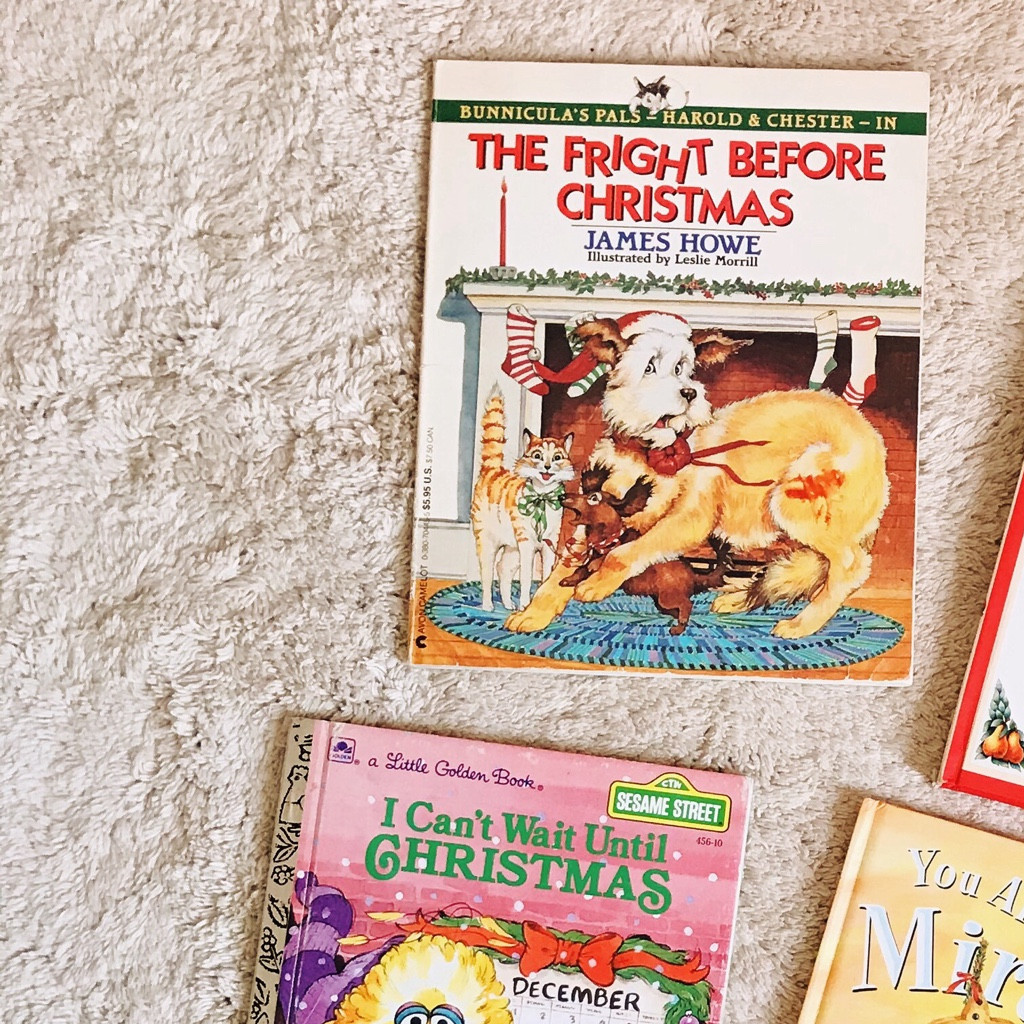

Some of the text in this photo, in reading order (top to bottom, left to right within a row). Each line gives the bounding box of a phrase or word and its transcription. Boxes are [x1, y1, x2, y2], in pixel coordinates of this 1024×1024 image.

[460, 105, 589, 122] BUNNICULA'S
[595, 108, 641, 124] PALS
[662, 109, 743, 127] HAROLD
[748, 113, 761, 127] &
[767, 113, 855, 129] CHESTER
[876, 116, 898, 131] IN
[468, 132, 887, 184] THE FRIGHT BEFORE
[557, 182, 794, 228] CHRISTMAS
[584, 230, 762, 256] JAMES HOWE
[587, 251, 759, 268] Illustrated by Leslie Morrill
[424, 466, 433, 484] U.S.
[422, 486, 432, 510] $5.95
[418, 565, 428, 607] CAMELOT
[417, 610, 427, 634] AVON
[368, 757, 379, 768] a
[385, 752, 430, 774] Little
[435, 760, 490, 783] Golden
[661, 779, 682, 790] CTW
[616, 792, 722, 823] SESAME STREET
[380, 797, 669, 864] I Can't Wait Until
[697, 837, 723, 848] 456-10
[365, 834, 673, 915] CHRISTMAS
[909, 848, 982, 899] You
[512, 977, 641, 1013] DECEMBER
